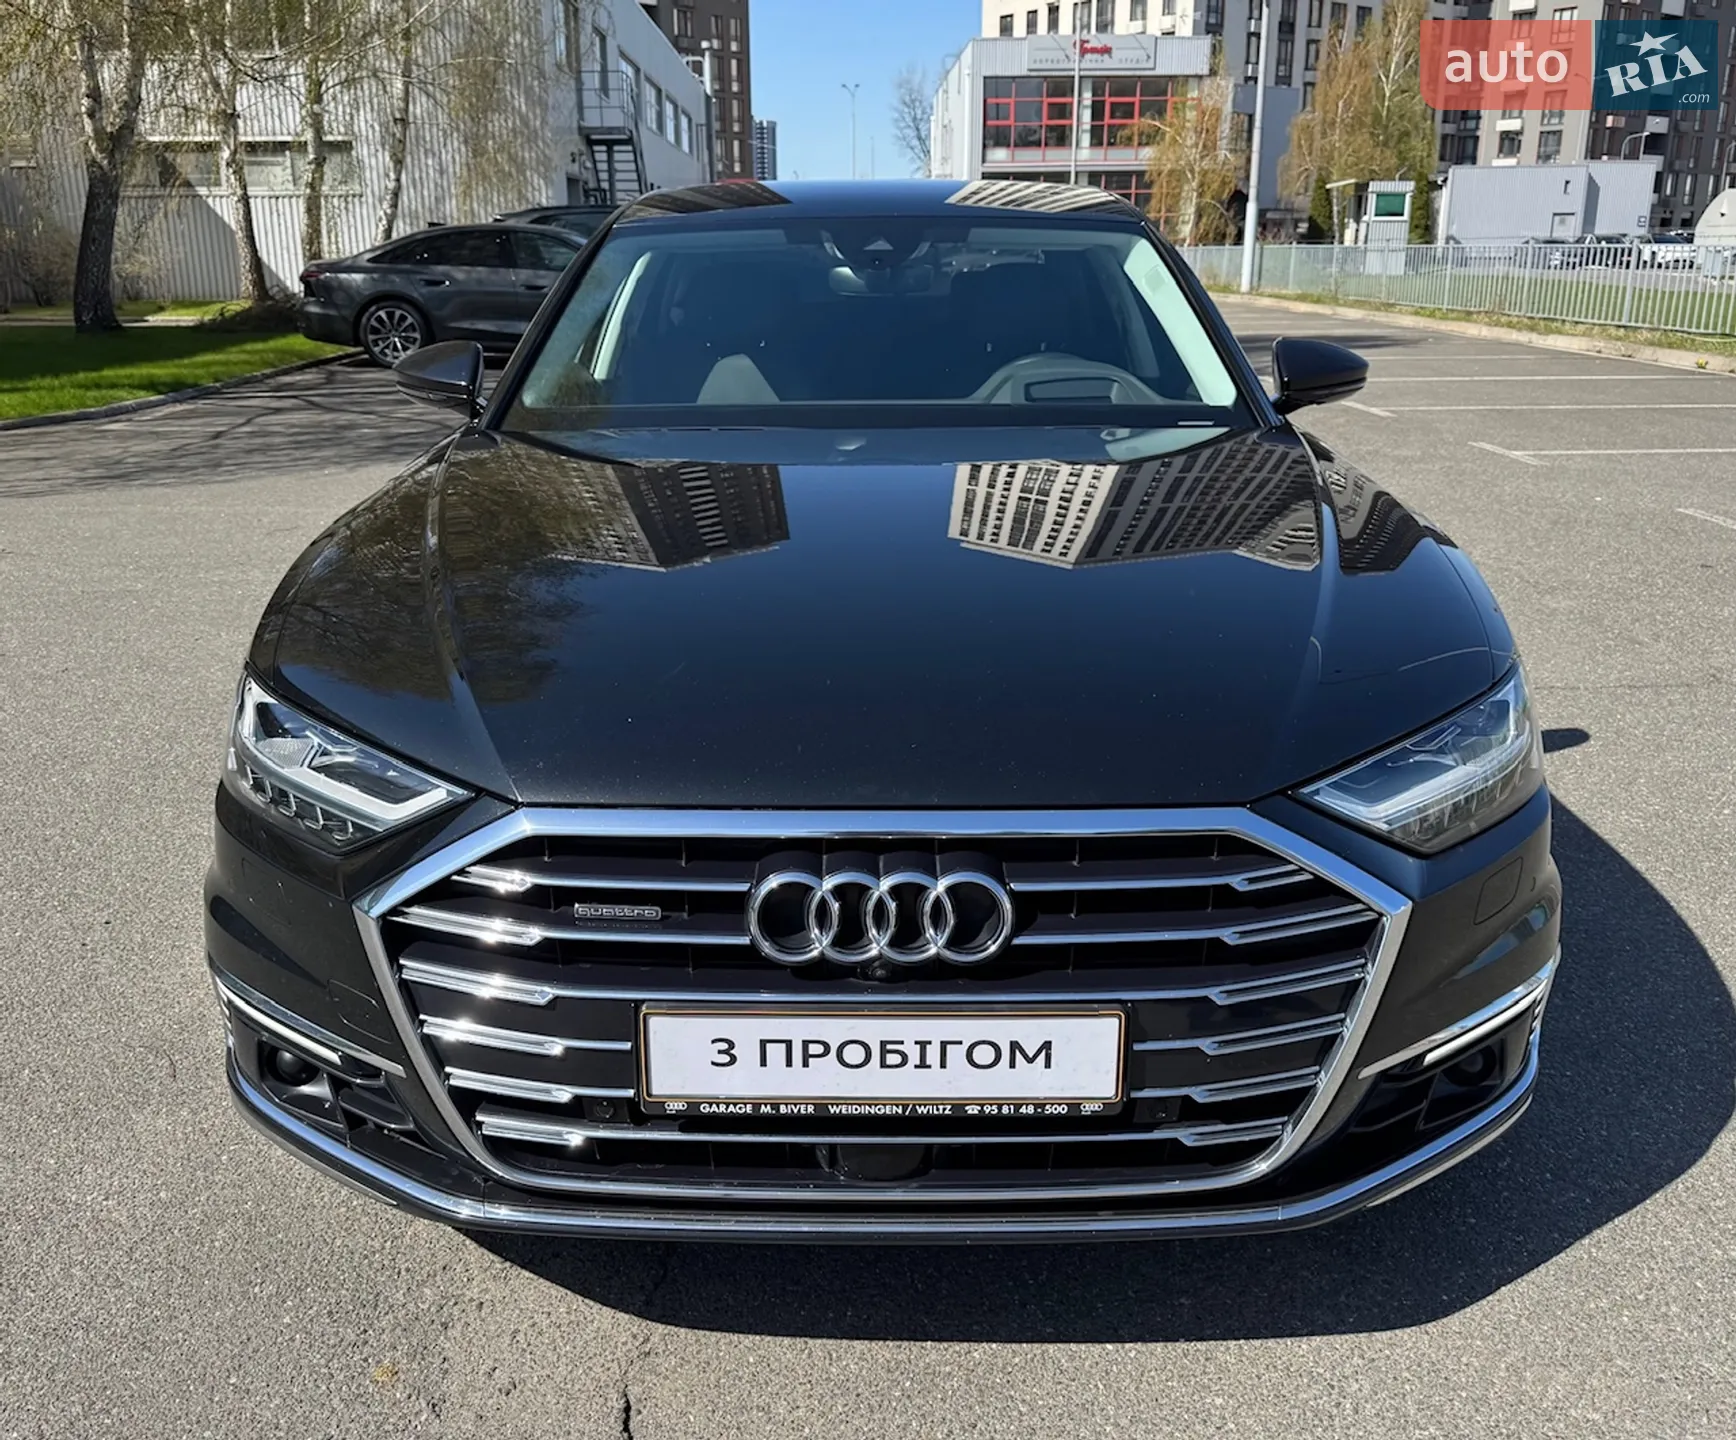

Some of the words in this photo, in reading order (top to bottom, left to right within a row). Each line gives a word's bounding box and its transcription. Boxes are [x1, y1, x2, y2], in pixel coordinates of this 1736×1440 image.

[578, 907, 657, 919] quattro
[710, 1037, 738, 1068] З
[759, 1038, 1053, 1070] ПРОБІГОМ
[699, 1103, 753, 1115] GARAGE
[759, 1103, 776, 1115] M.
[779, 1104, 815, 1115] BIVER
[827, 1104, 903, 1115] WEIDINGEN
[915, 1104, 952, 1115] WILTZ
[984, 1104, 999, 1115] 95
[1001, 1104, 1014, 1115] 81
[1018, 1104, 1035, 1115] 48
[1044, 1104, 1068, 1115] 500
